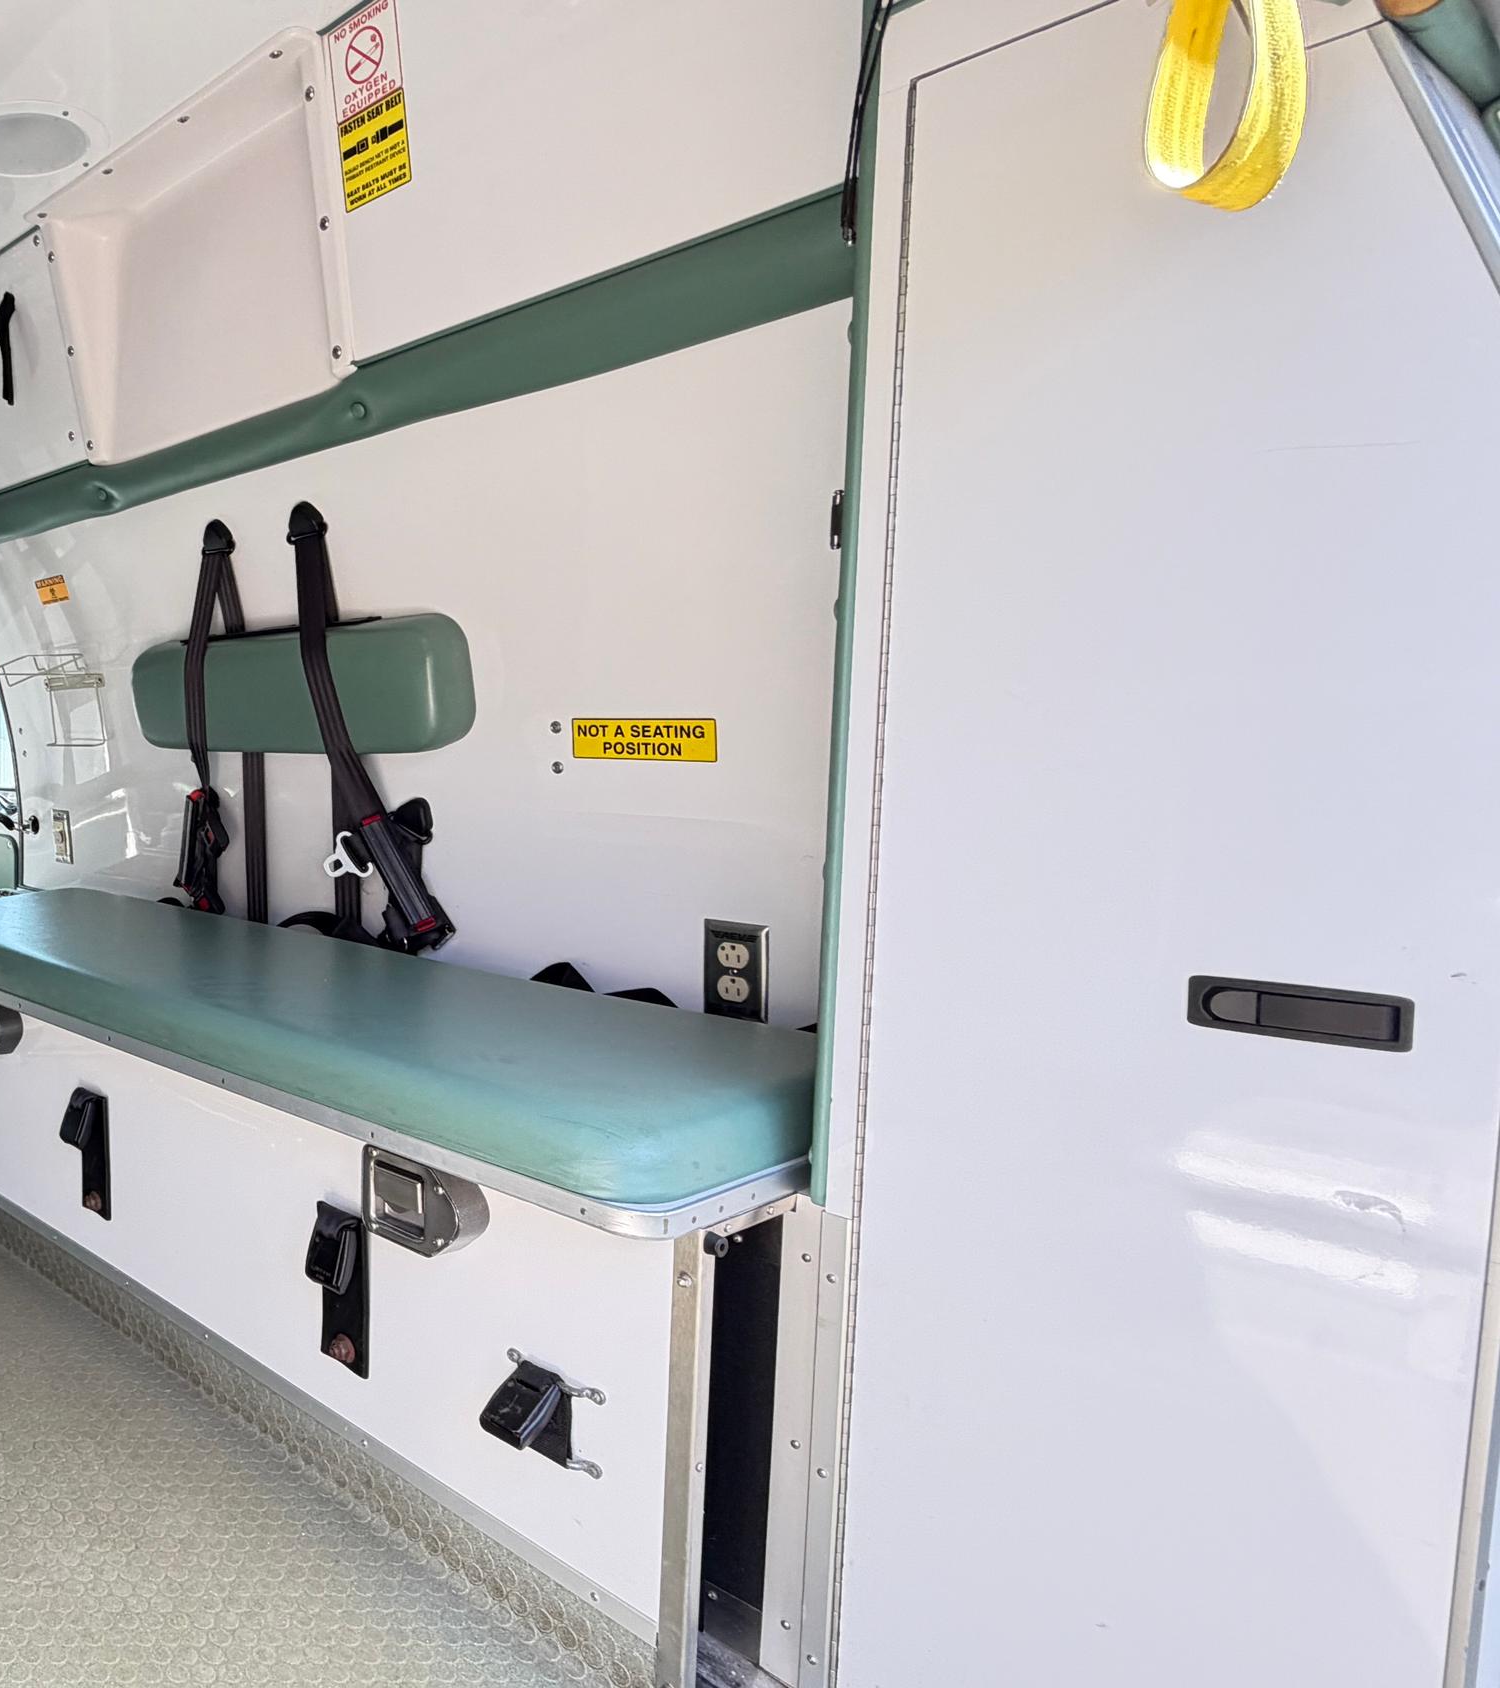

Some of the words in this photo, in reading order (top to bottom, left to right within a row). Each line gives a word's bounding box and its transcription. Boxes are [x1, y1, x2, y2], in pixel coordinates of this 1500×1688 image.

[333, 29, 347, 44] NO
[348, 1, 388, 33] SMOKING
[342, 79, 396, 118] EQUIPPED
[344, 71, 388, 105] OXYGEN
[340, 113, 366, 138] FASTEN
[366, 103, 384, 122] SEAT
[384, 92, 402, 112] BELT
[389, 141, 400, 150] NOT
[347, 187, 360, 199] SEAT
[361, 176, 379, 191] BELTS
[380, 167, 397, 181] MUST
[398, 162, 407, 172] BE
[349, 193, 367, 206] WORN
[368, 188, 375, 197] AT
[376, 182, 387, 193] ALL
[388, 172, 407, 186] TIMES
[577, 725, 608, 737] NOT
[614, 725, 625, 738] A
[630, 725, 705, 739] SEATING
[603, 742, 682, 756] POSITION
